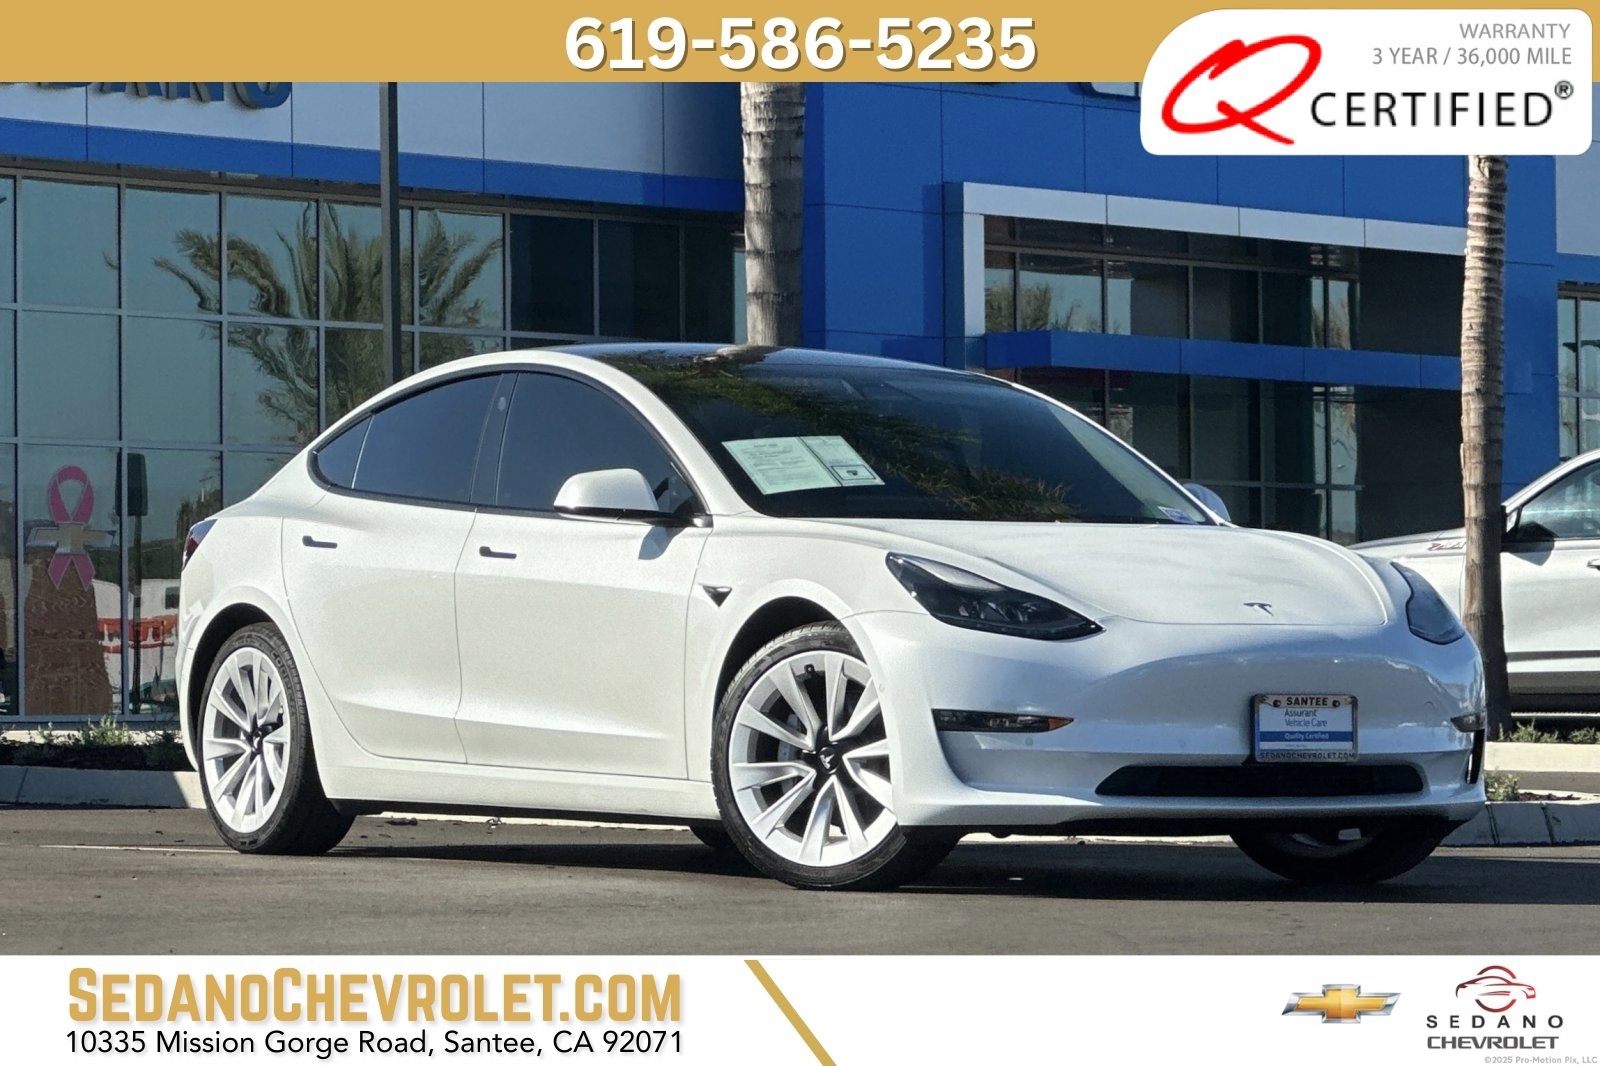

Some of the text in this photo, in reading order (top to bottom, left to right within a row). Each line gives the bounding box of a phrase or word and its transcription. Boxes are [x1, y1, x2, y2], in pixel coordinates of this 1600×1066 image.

[1286, 697, 1328, 706] SANTEE
[1284, 709, 1317, 717] Assurant
[1285, 719, 1328, 727] Vehicle Care
[1284, 733, 1304, 741] Quality
[1261, 751, 1355, 760] SEDANOCHEVROLET.COM
